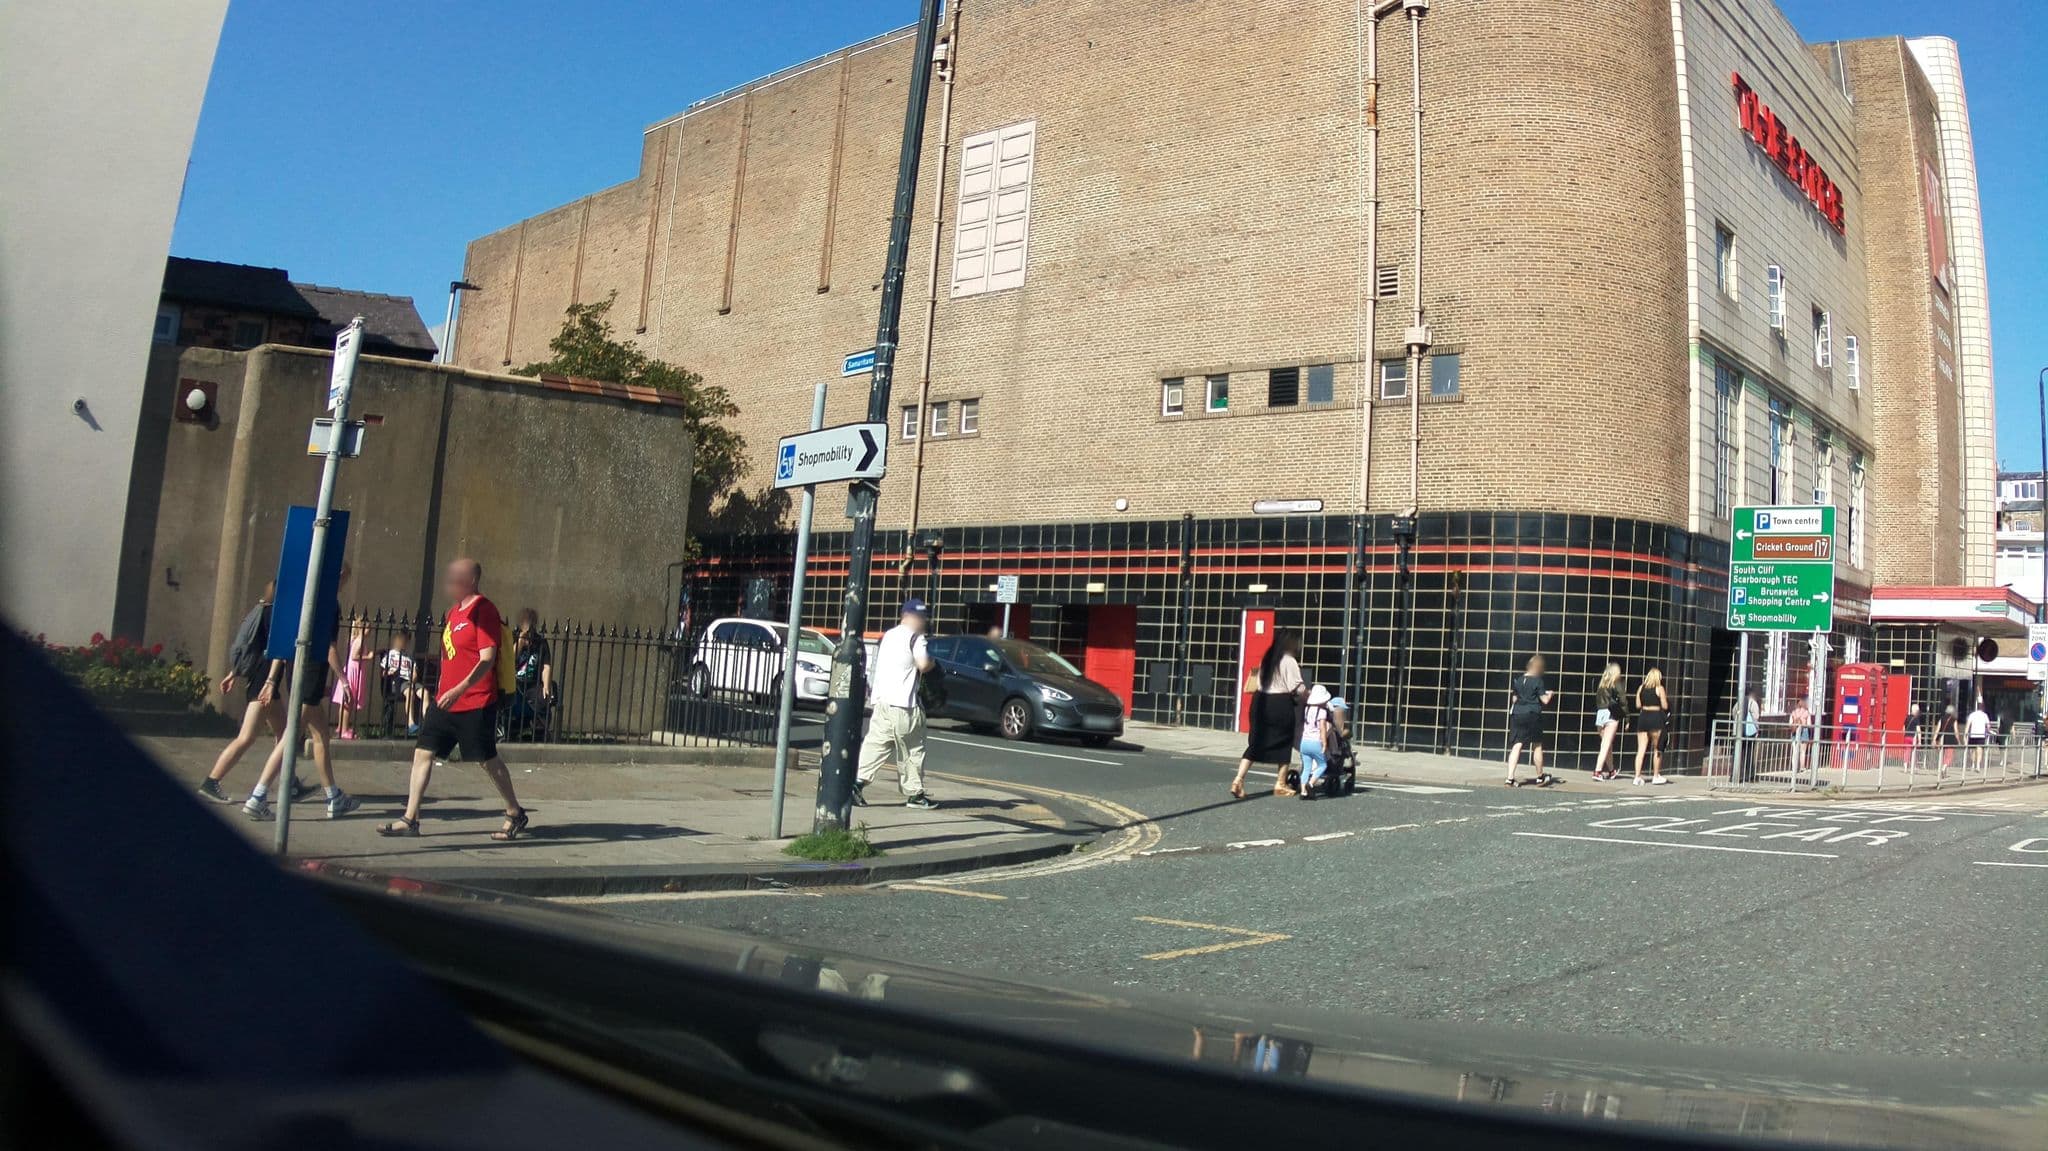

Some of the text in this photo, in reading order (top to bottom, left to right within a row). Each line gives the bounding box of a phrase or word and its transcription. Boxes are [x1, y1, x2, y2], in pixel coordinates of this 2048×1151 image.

[798, 445, 853, 467] Shopmobility
[1773, 516, 1793, 525] Town
[1794, 516, 1820, 526] centre
[1756, 542, 1813, 552] Cricket Ground
[1733, 565, 1775, 574] South Cliff
[1733, 575, 1798, 586] Scarborough TEC
[1760, 587, 1799, 596] Brunswick
[1748, 597, 1783, 607] Shopping
[1785, 597, 1811, 606] Centre
[1748, 613, 1797, 624] Shopmobility
[1711, 806, 1945, 823] KEEP
[1588, 816, 1909, 846] CLEAR
